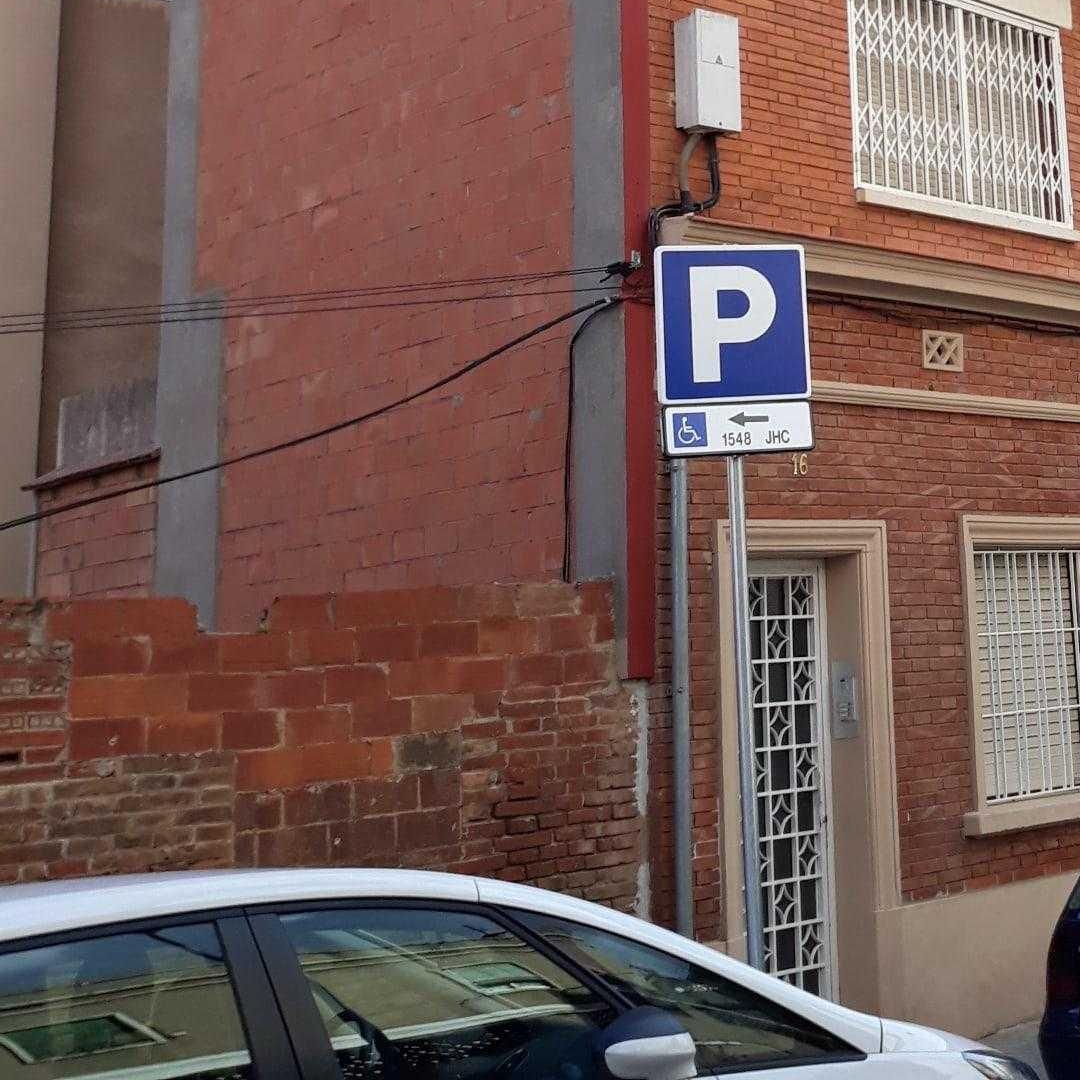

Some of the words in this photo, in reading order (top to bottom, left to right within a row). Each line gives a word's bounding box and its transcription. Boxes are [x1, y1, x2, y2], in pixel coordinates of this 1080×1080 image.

[689, 265, 777, 383] P
[722, 431, 752, 447] 1548
[765, 430, 791, 445] JHC
[791, 453, 809, 475] 16
